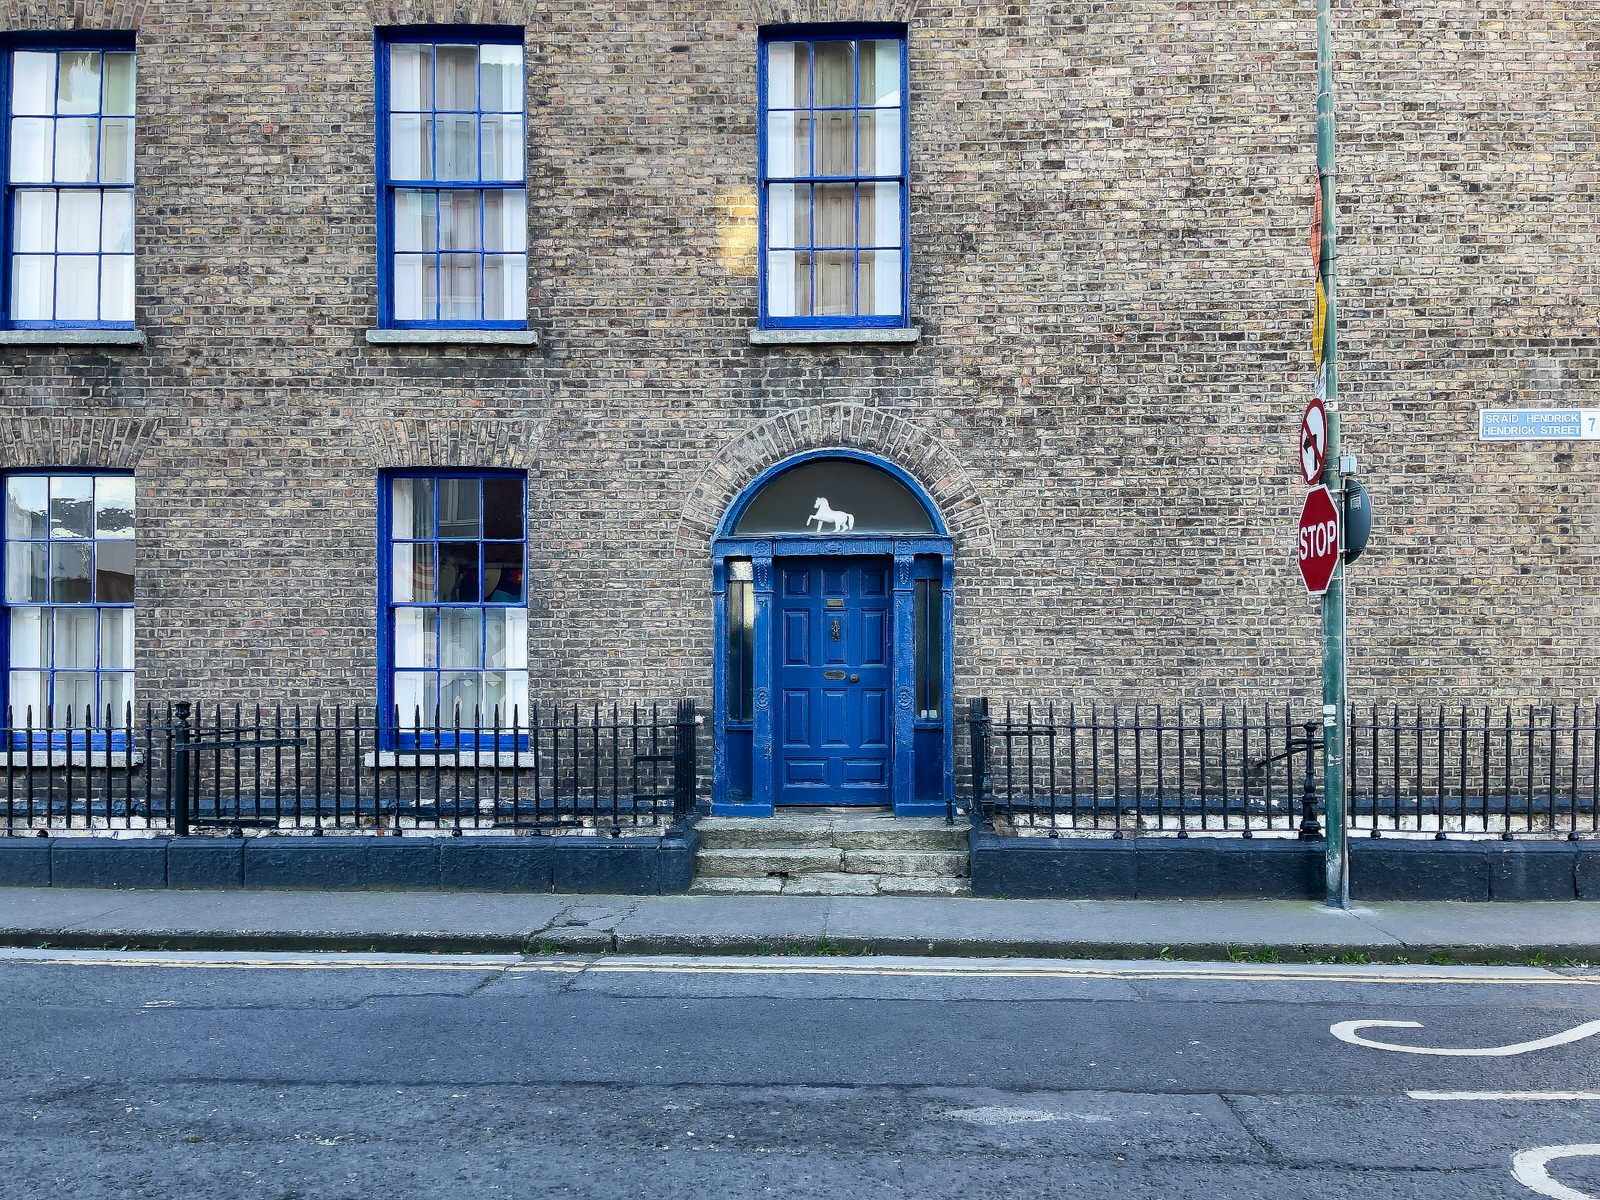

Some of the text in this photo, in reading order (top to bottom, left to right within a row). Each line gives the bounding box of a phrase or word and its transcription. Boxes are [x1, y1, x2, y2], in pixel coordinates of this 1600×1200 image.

[1526, 413, 1579, 423] HENDRICK
[1483, 425, 1581, 435] HENDRICK STREET
[1588, 417, 1597, 432] 7
[1300, 520, 1336, 560] STOP
